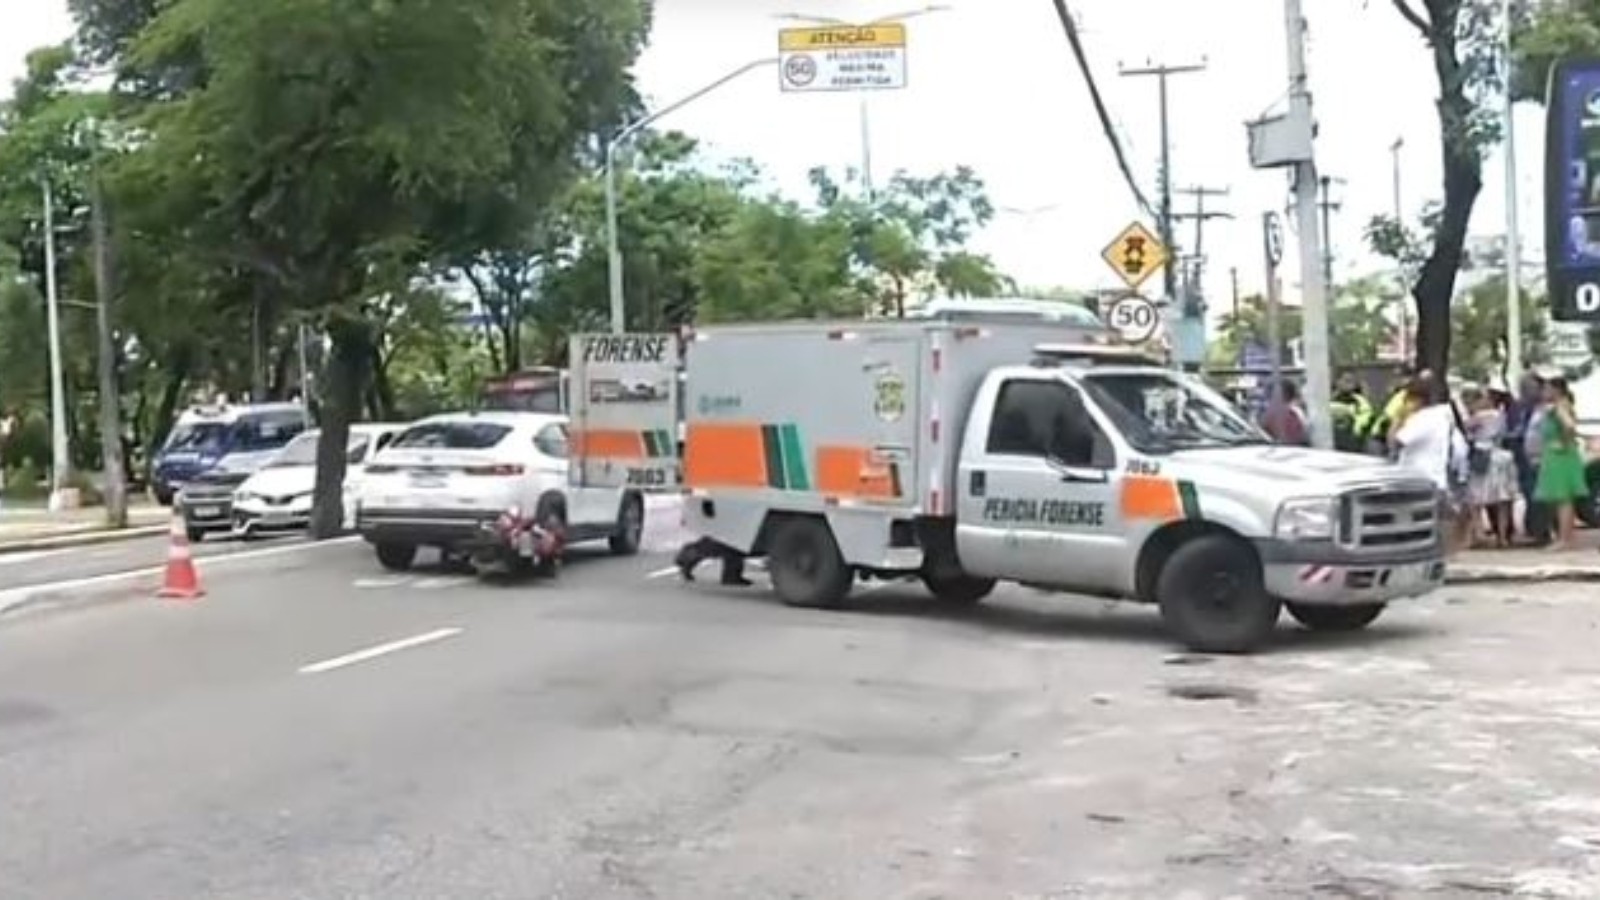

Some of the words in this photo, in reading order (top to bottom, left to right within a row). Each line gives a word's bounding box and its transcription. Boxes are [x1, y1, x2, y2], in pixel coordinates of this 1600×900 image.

[809, 28, 876, 44] ATENÇÃO
[1117, 304, 1151, 328] 50
[583, 336, 668, 363] FORENSE
[1040, 500, 1104, 526] FORENSE
